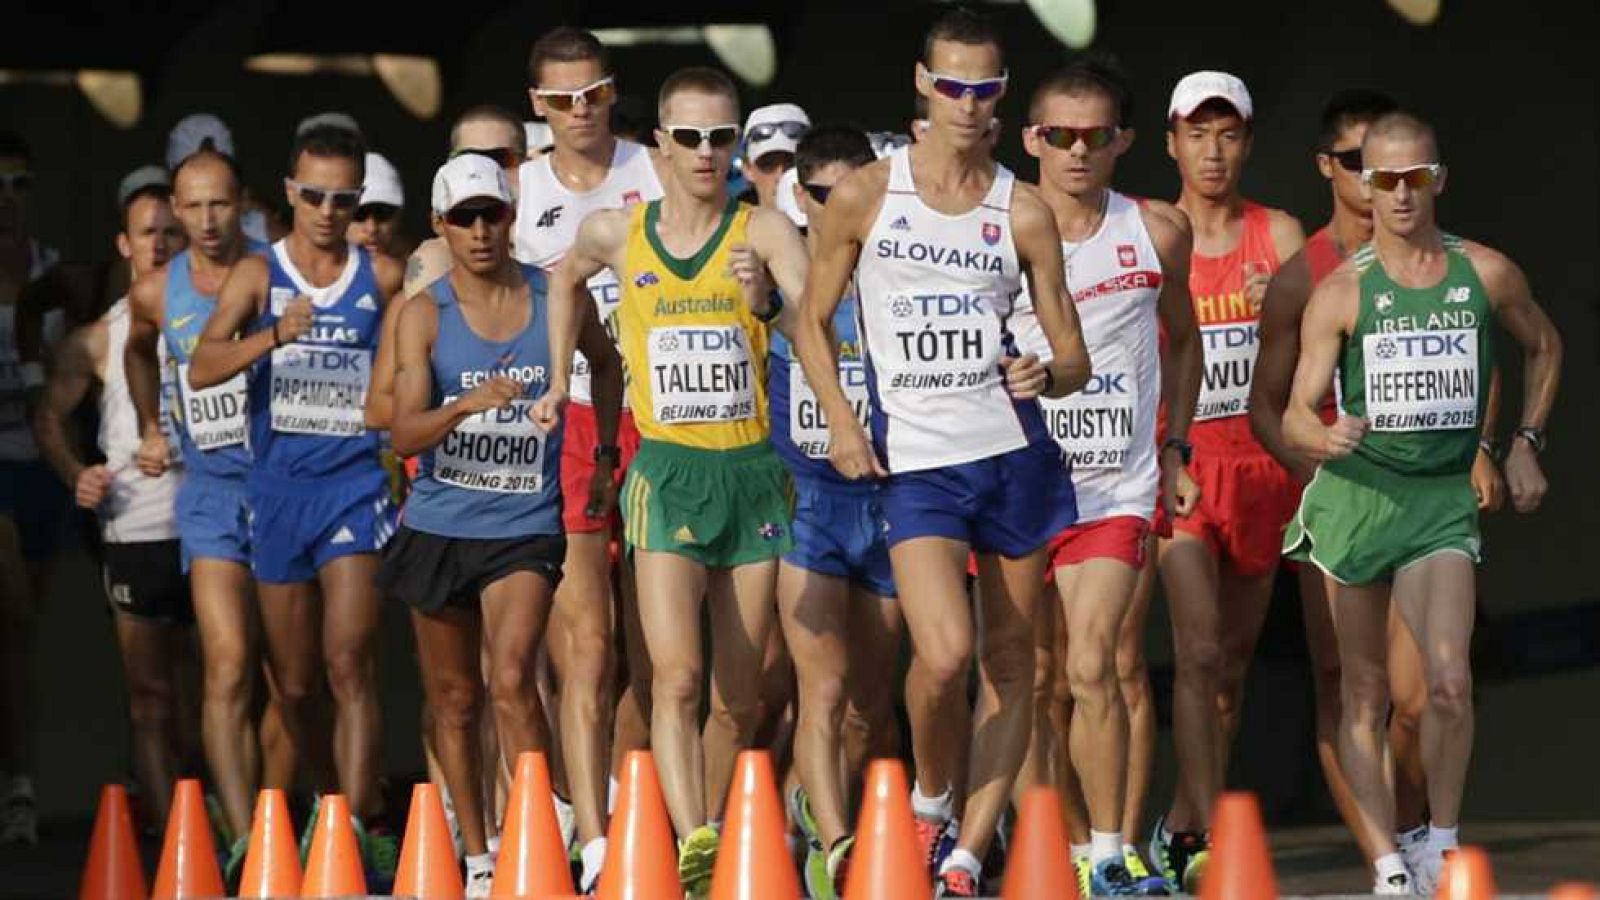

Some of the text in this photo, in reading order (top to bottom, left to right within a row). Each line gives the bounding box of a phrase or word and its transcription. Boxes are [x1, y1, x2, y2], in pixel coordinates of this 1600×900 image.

[877, 239, 1004, 275] SLOVAKIA
[655, 293, 735, 316] Australia
[913, 294, 985, 317] TDK
[1376, 310, 1476, 334] IRELAND
[678, 326, 743, 351] TDK
[897, 323, 983, 362] TÓTH
[1397, 333, 1468, 357] TDK
[302, 350, 361, 371] TDK
[654, 361, 749, 394] TALLENT
[891, 372, 953, 389] BEIJING
[1081, 373, 1128, 395] DK
[1203, 359, 1250, 391] WU
[1370, 368, 1475, 403] HEFFERNAN
[660, 401, 751, 421] BEIJING 2015
[1375, 410, 1474, 429] BEIJING 2015
[442, 430, 539, 465] CHOCHO
[440, 466, 537, 491] BEIJING 2015
